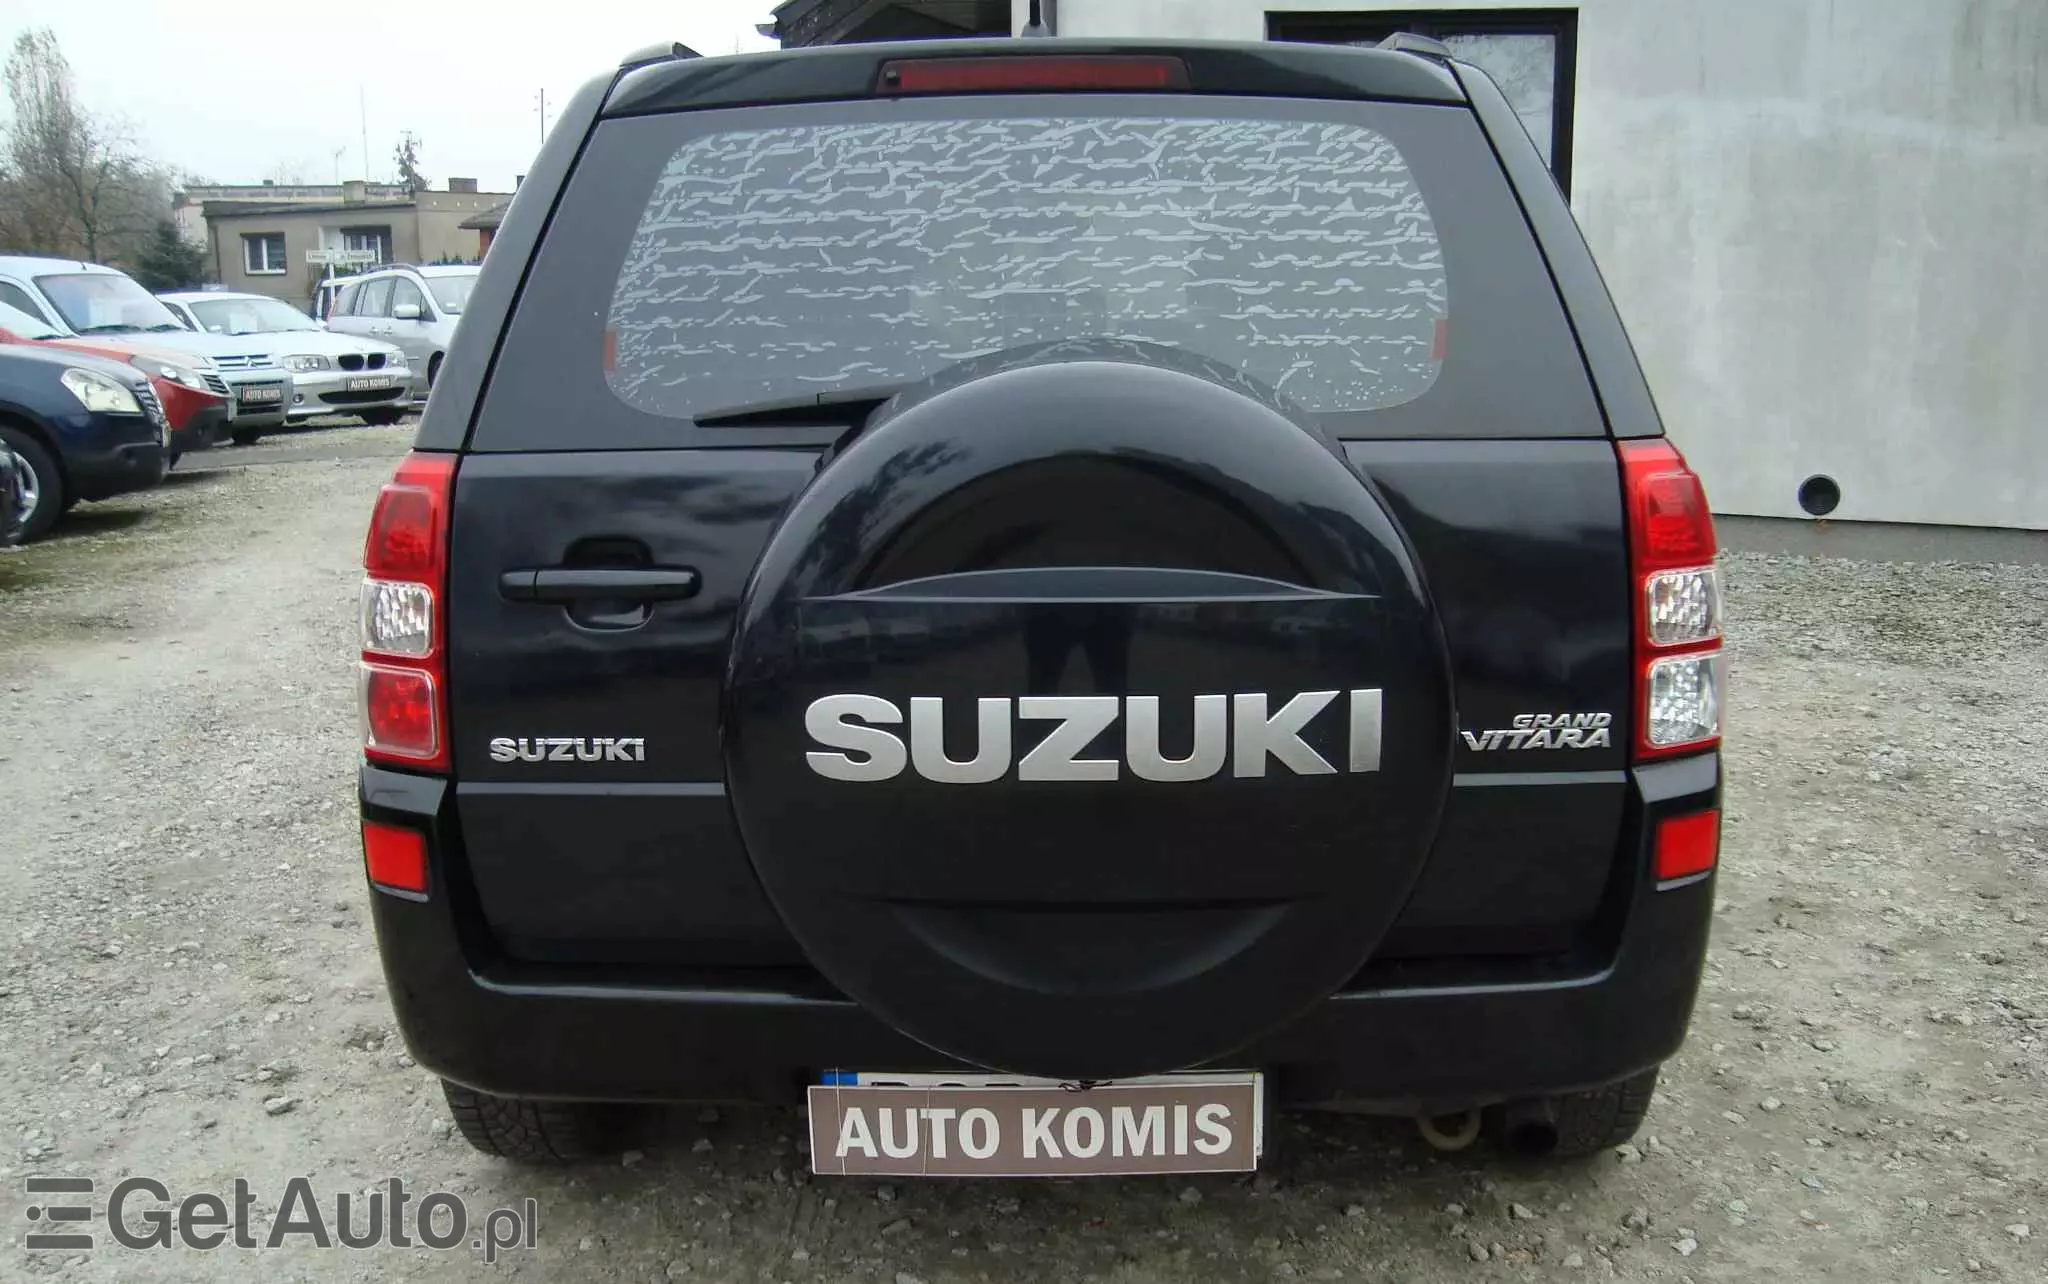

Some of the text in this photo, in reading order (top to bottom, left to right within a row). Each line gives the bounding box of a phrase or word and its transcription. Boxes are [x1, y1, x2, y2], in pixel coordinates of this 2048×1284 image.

[246, 390, 262, 399] AUTO
[351, 377, 390, 389] AUTO KOMIS
[1512, 712, 1612, 729] GRAND
[804, 688, 1383, 783] SUZUKI
[1460, 728, 1611, 751] VITARA
[489, 737, 645, 762] SUZUKI
[835, 1103, 1233, 1159] AUTO KOMIS
